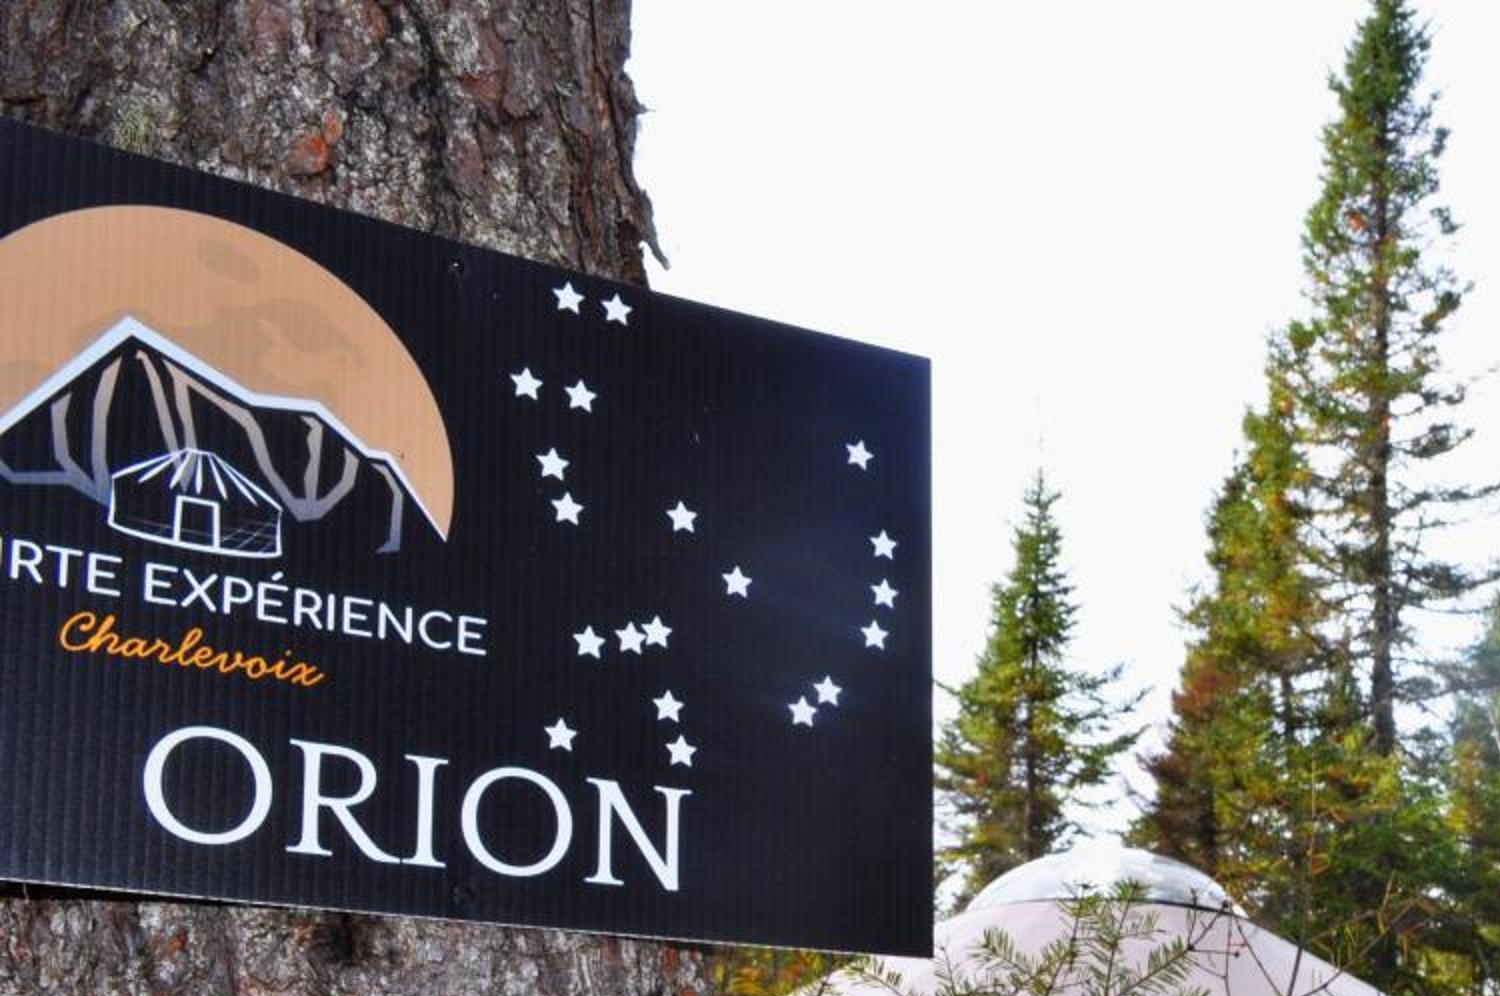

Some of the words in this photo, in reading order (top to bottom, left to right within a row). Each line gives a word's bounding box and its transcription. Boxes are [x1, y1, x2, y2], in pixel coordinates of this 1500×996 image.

[0, 537, 123, 597] RTE
[143, 561, 488, 656] EXPÉRIENCE
[59, 611, 325, 688] Charlevoix
[143, 725, 692, 892] ORION
